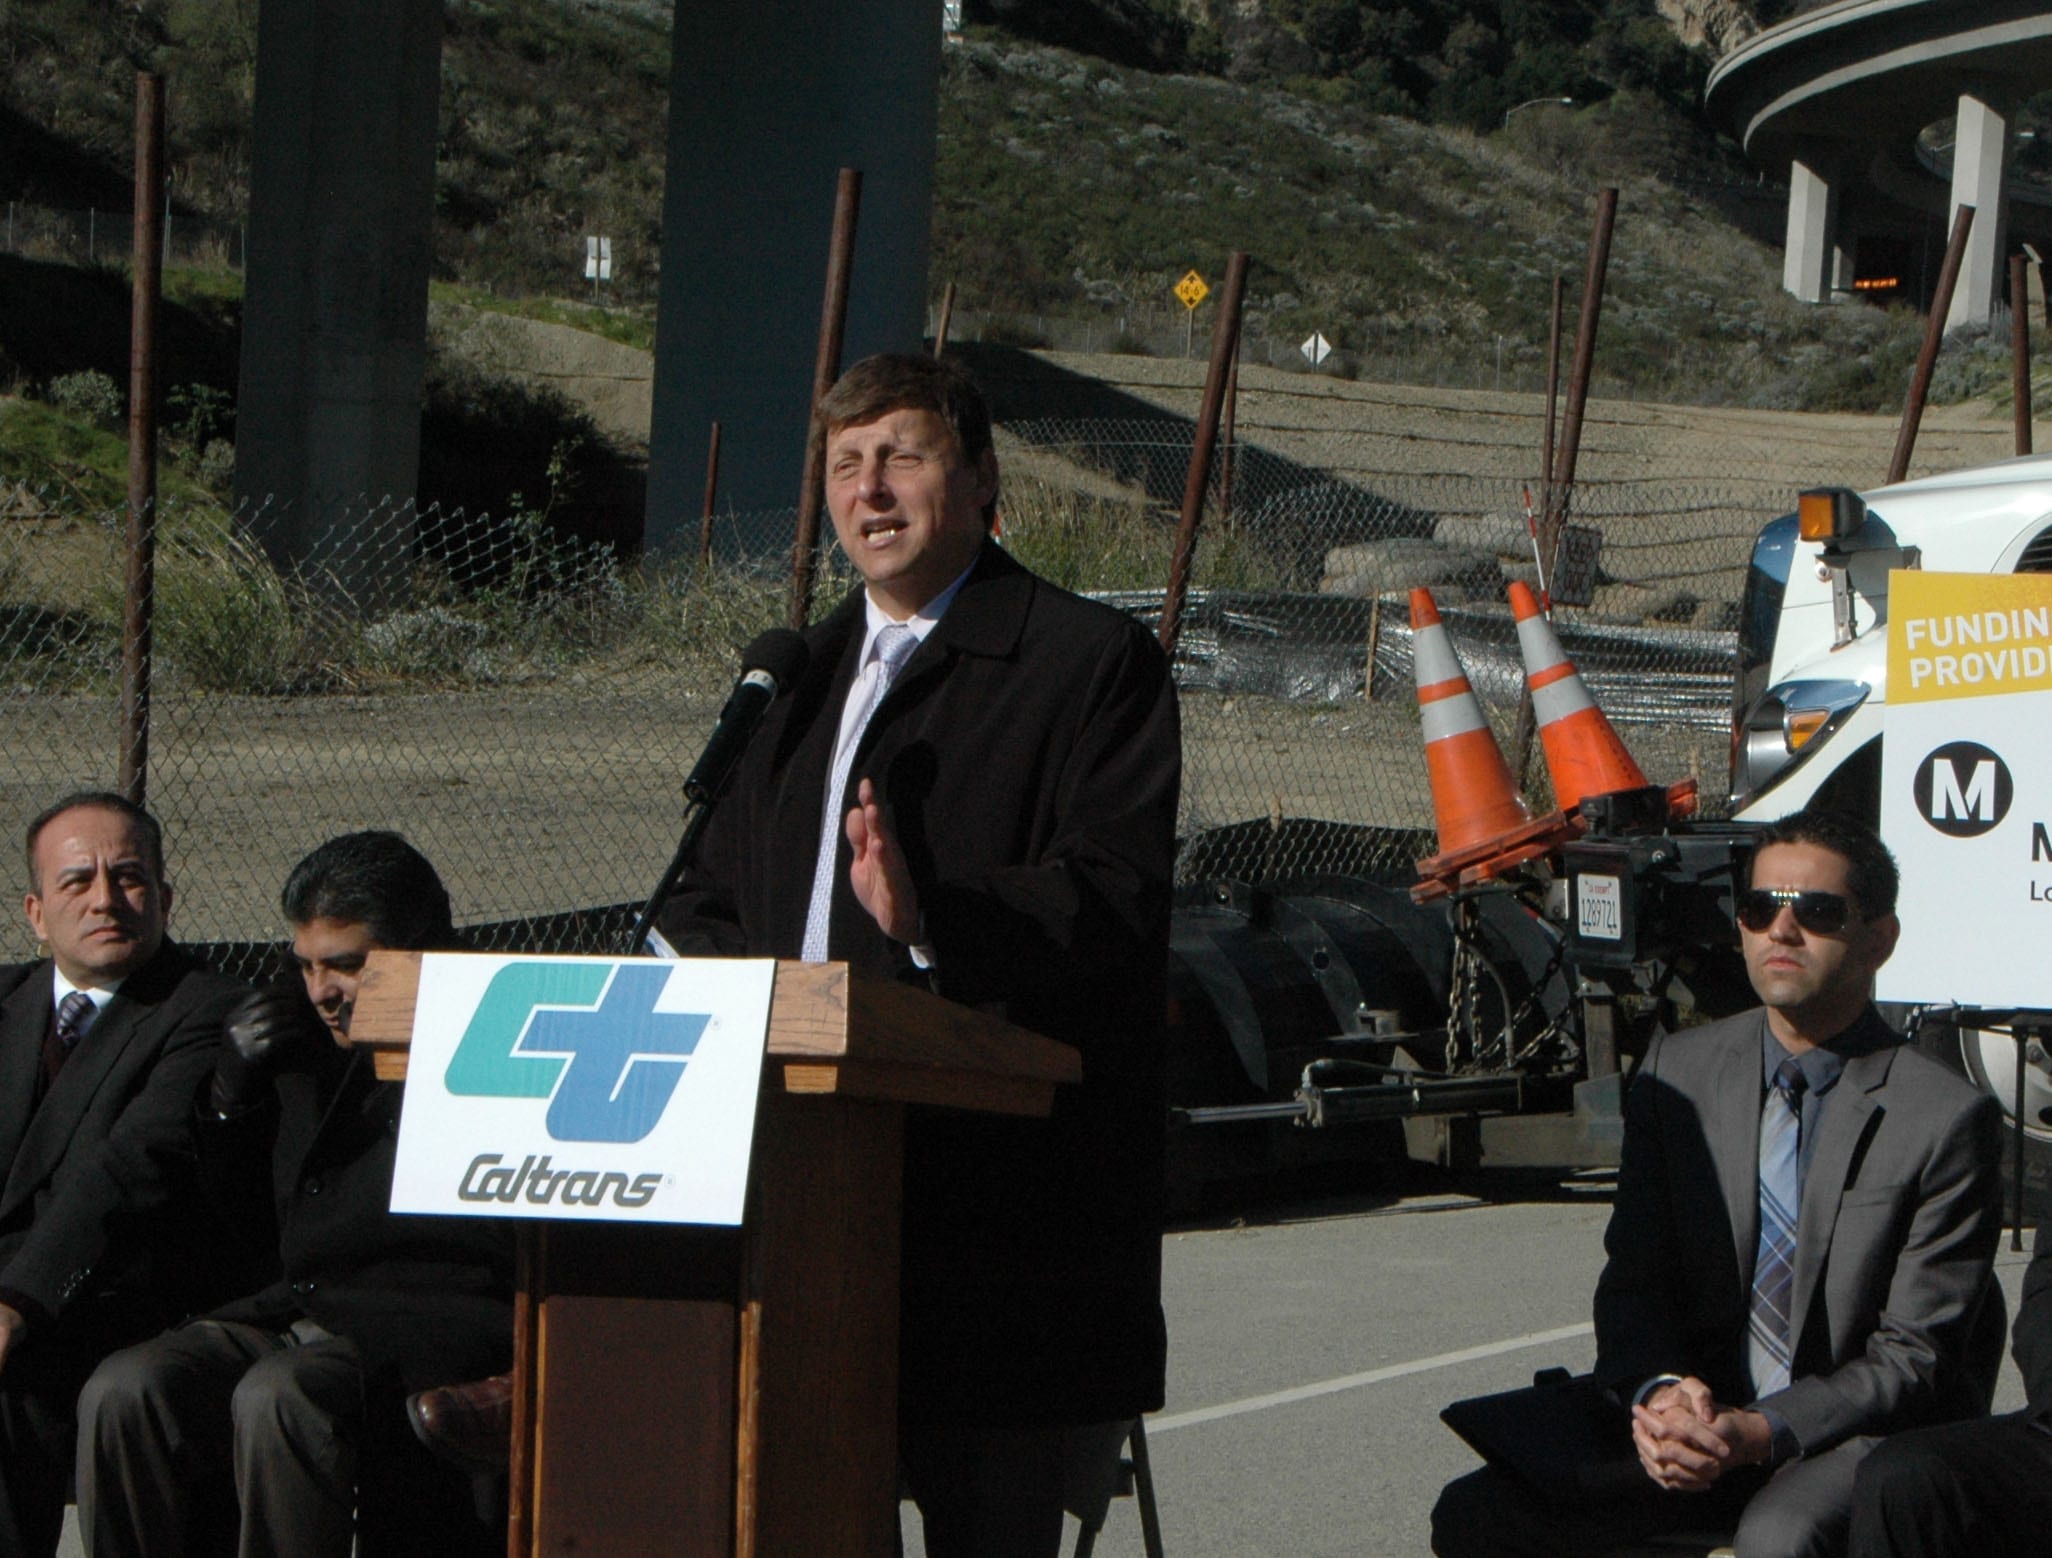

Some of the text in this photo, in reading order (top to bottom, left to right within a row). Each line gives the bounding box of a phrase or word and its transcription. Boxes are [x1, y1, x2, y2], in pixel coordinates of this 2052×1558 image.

[1909, 644, 2052, 689] PROVID
[1931, 758, 1996, 821] M
[458, 1153, 664, 1208] Caltrans
